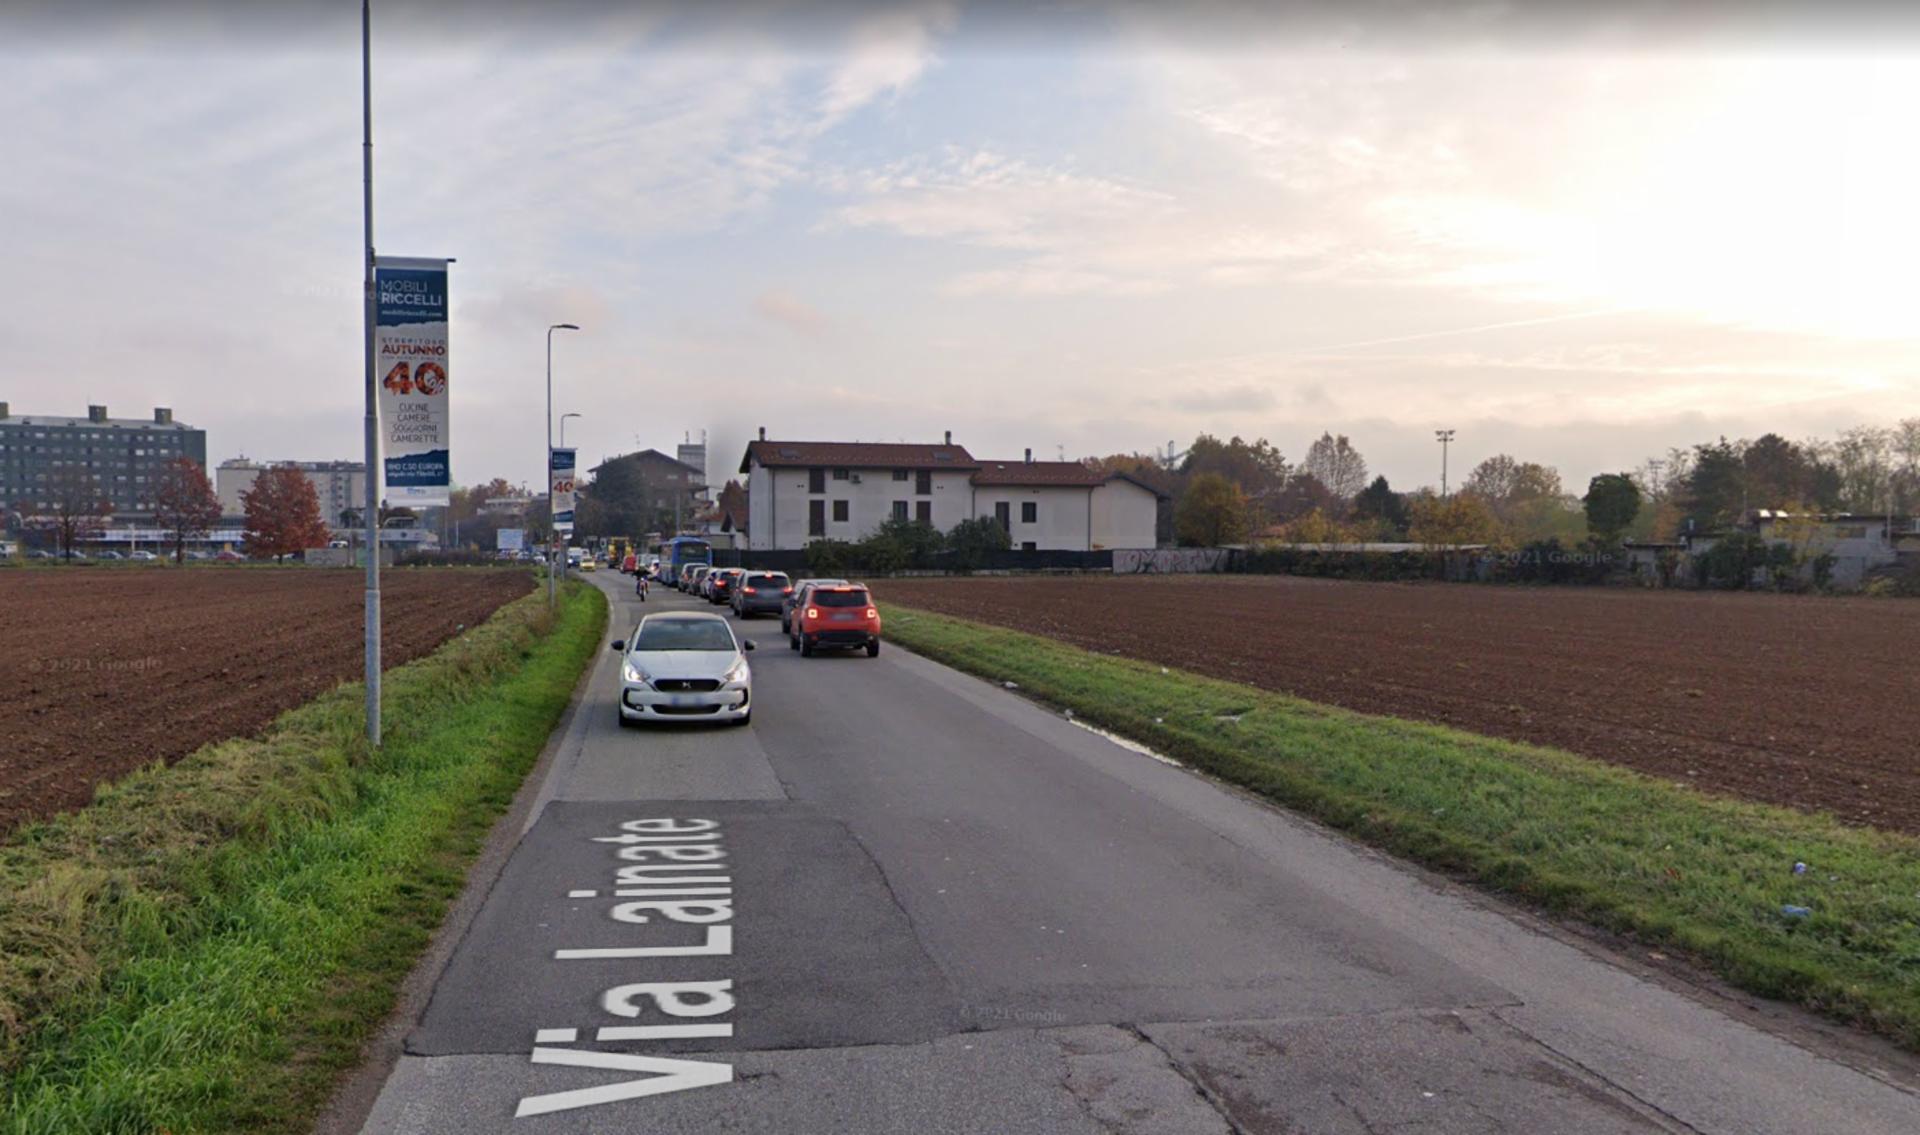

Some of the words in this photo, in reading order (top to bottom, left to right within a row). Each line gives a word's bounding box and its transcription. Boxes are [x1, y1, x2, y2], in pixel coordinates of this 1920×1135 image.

[380, 280, 428, 293] MOBILI
[381, 292, 443, 306] RICCELLI
[381, 344, 446, 356] AUTUNNO
[398, 402, 429, 412] CUCINE
[397, 413, 430, 422] CAMERE
[392, 423, 437, 433] SOGGIORNI
[391, 434, 439, 444] CAMERETTE
